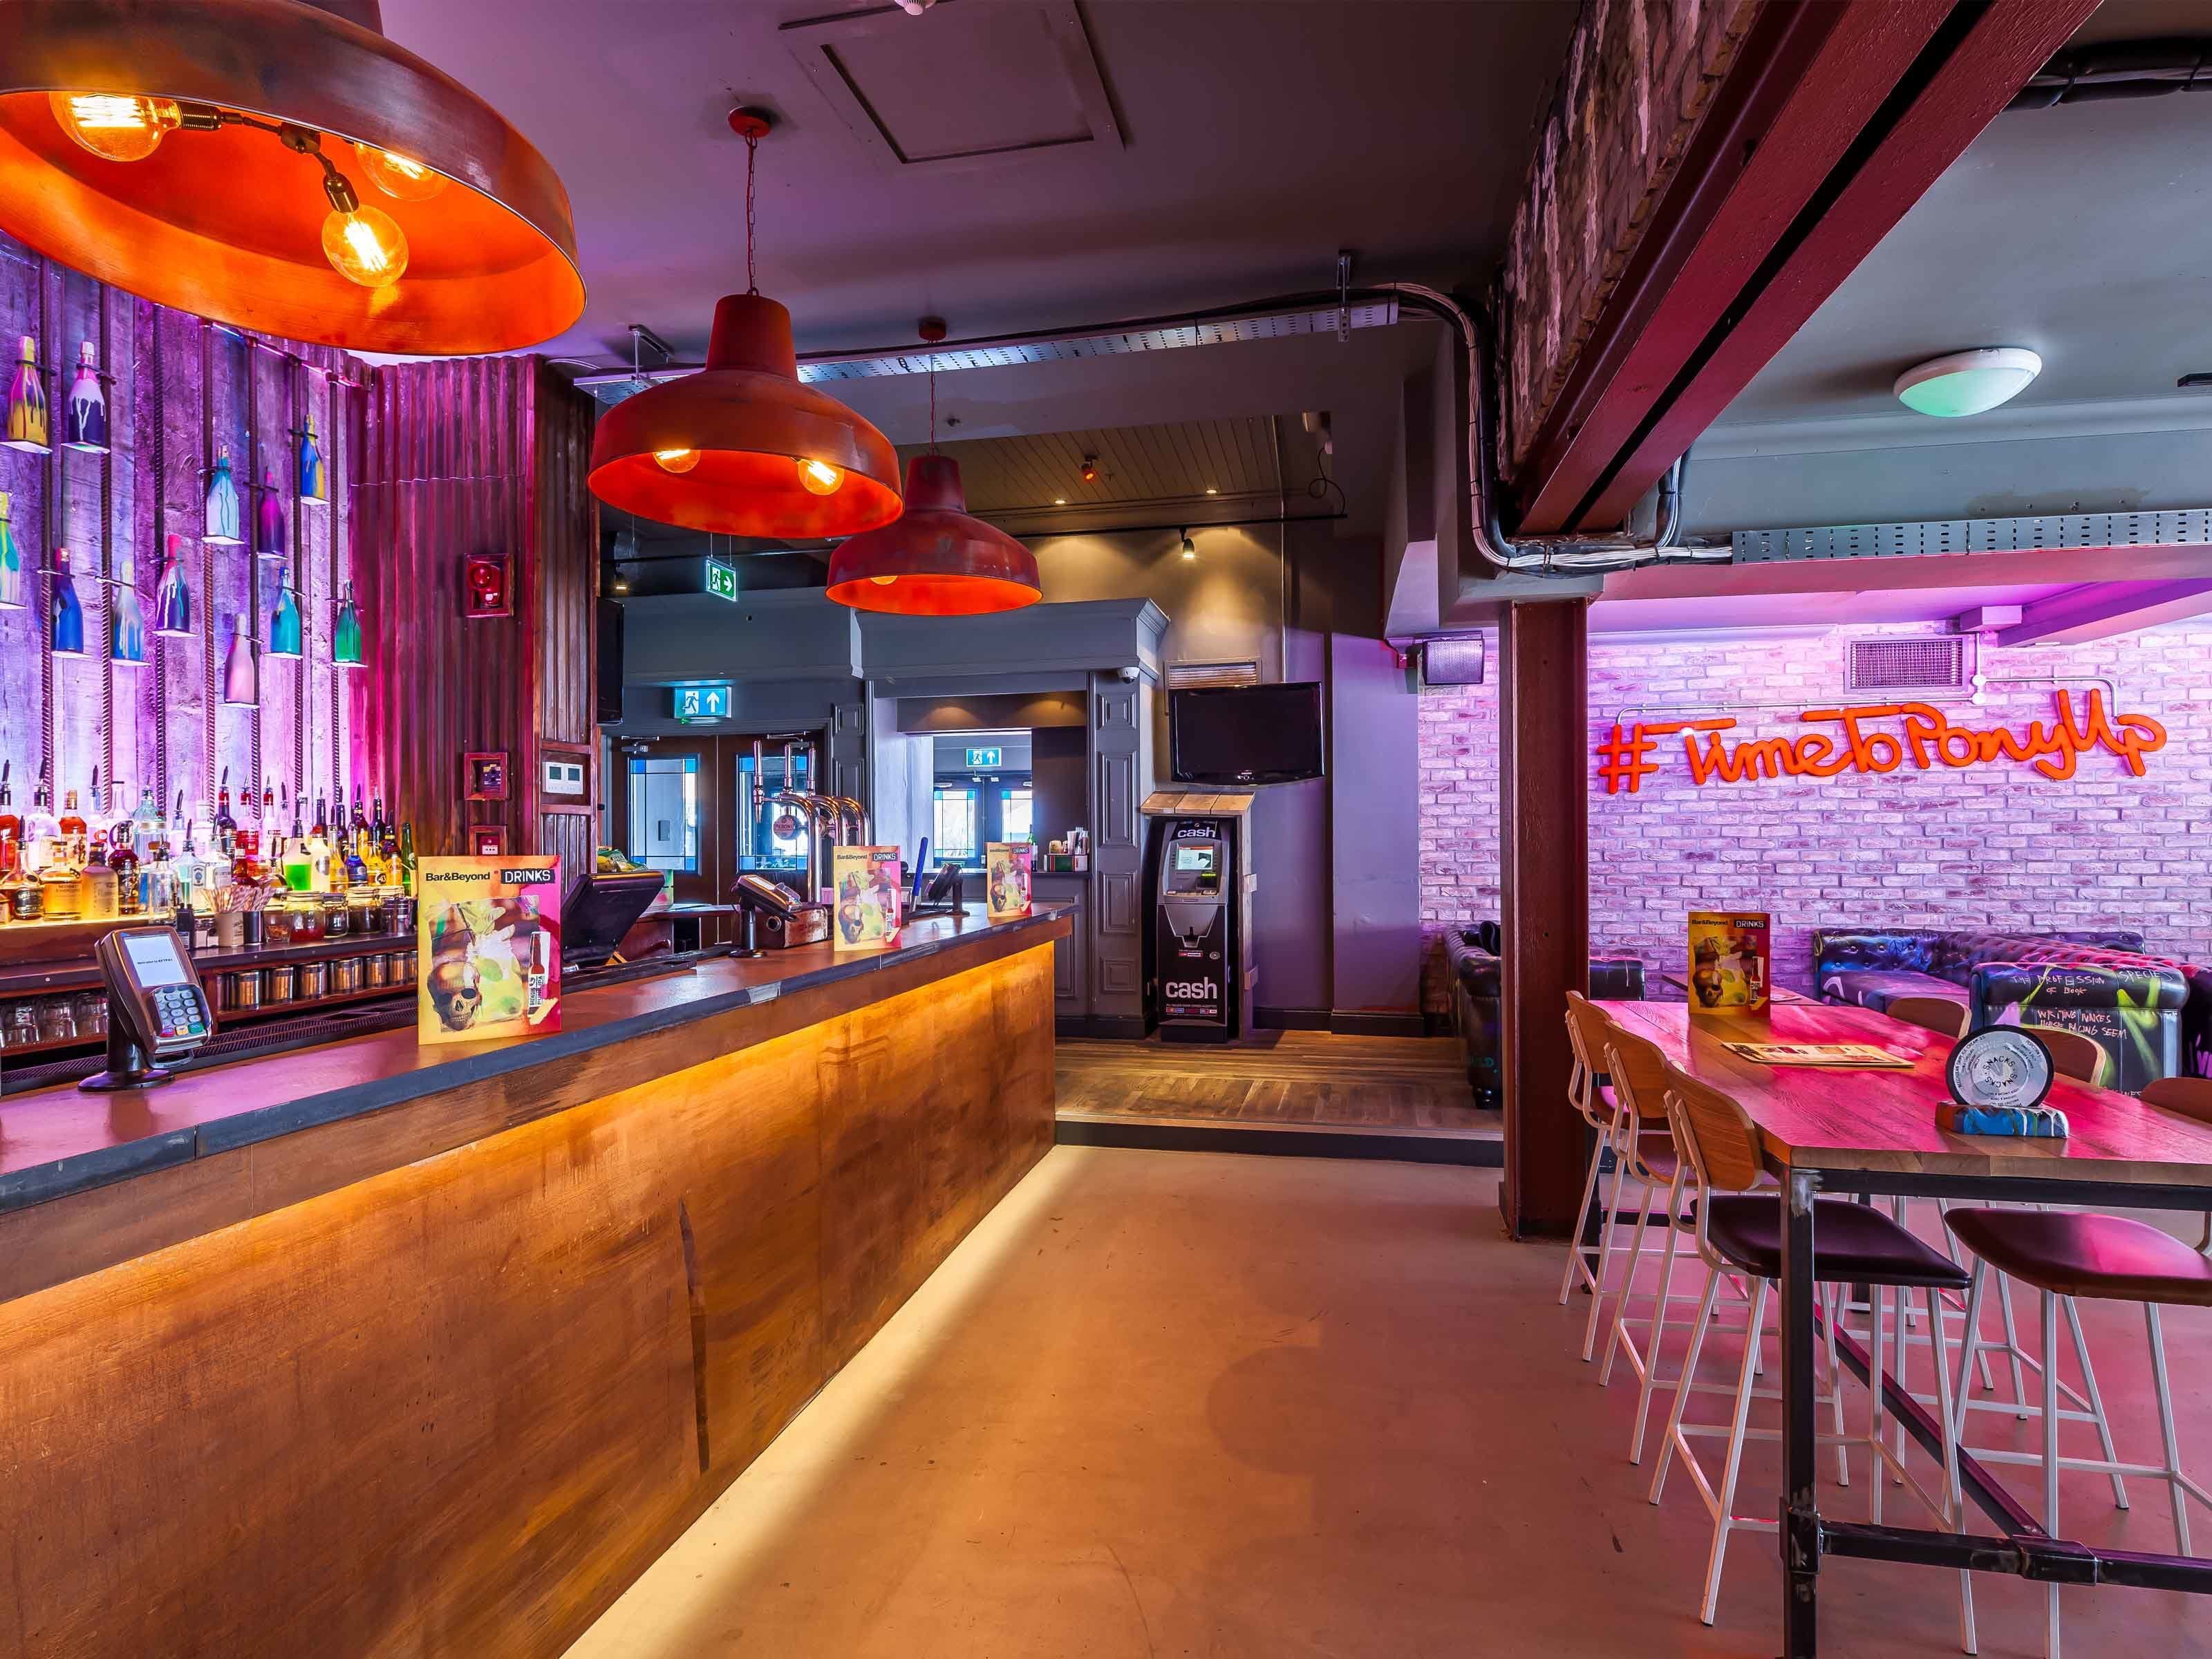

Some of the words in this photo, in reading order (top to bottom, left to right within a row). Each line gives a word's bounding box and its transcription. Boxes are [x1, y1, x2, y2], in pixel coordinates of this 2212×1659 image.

[1597, 688, 2167, 794] #TimeToPonyUp
[1177, 827, 1216, 838] cash
[425, 872, 490, 882] Bar&Beyond
[505, 870, 551, 883] DRINKS
[1736, 920, 1764, 928] DRINKS
[1165, 977, 1217, 999] cash
[2101, 1027, 2128, 1040] SEEM
[1983, 1056, 2016, 1070] SNACKS
[1985, 1074, 2018, 1088] SNACKS
